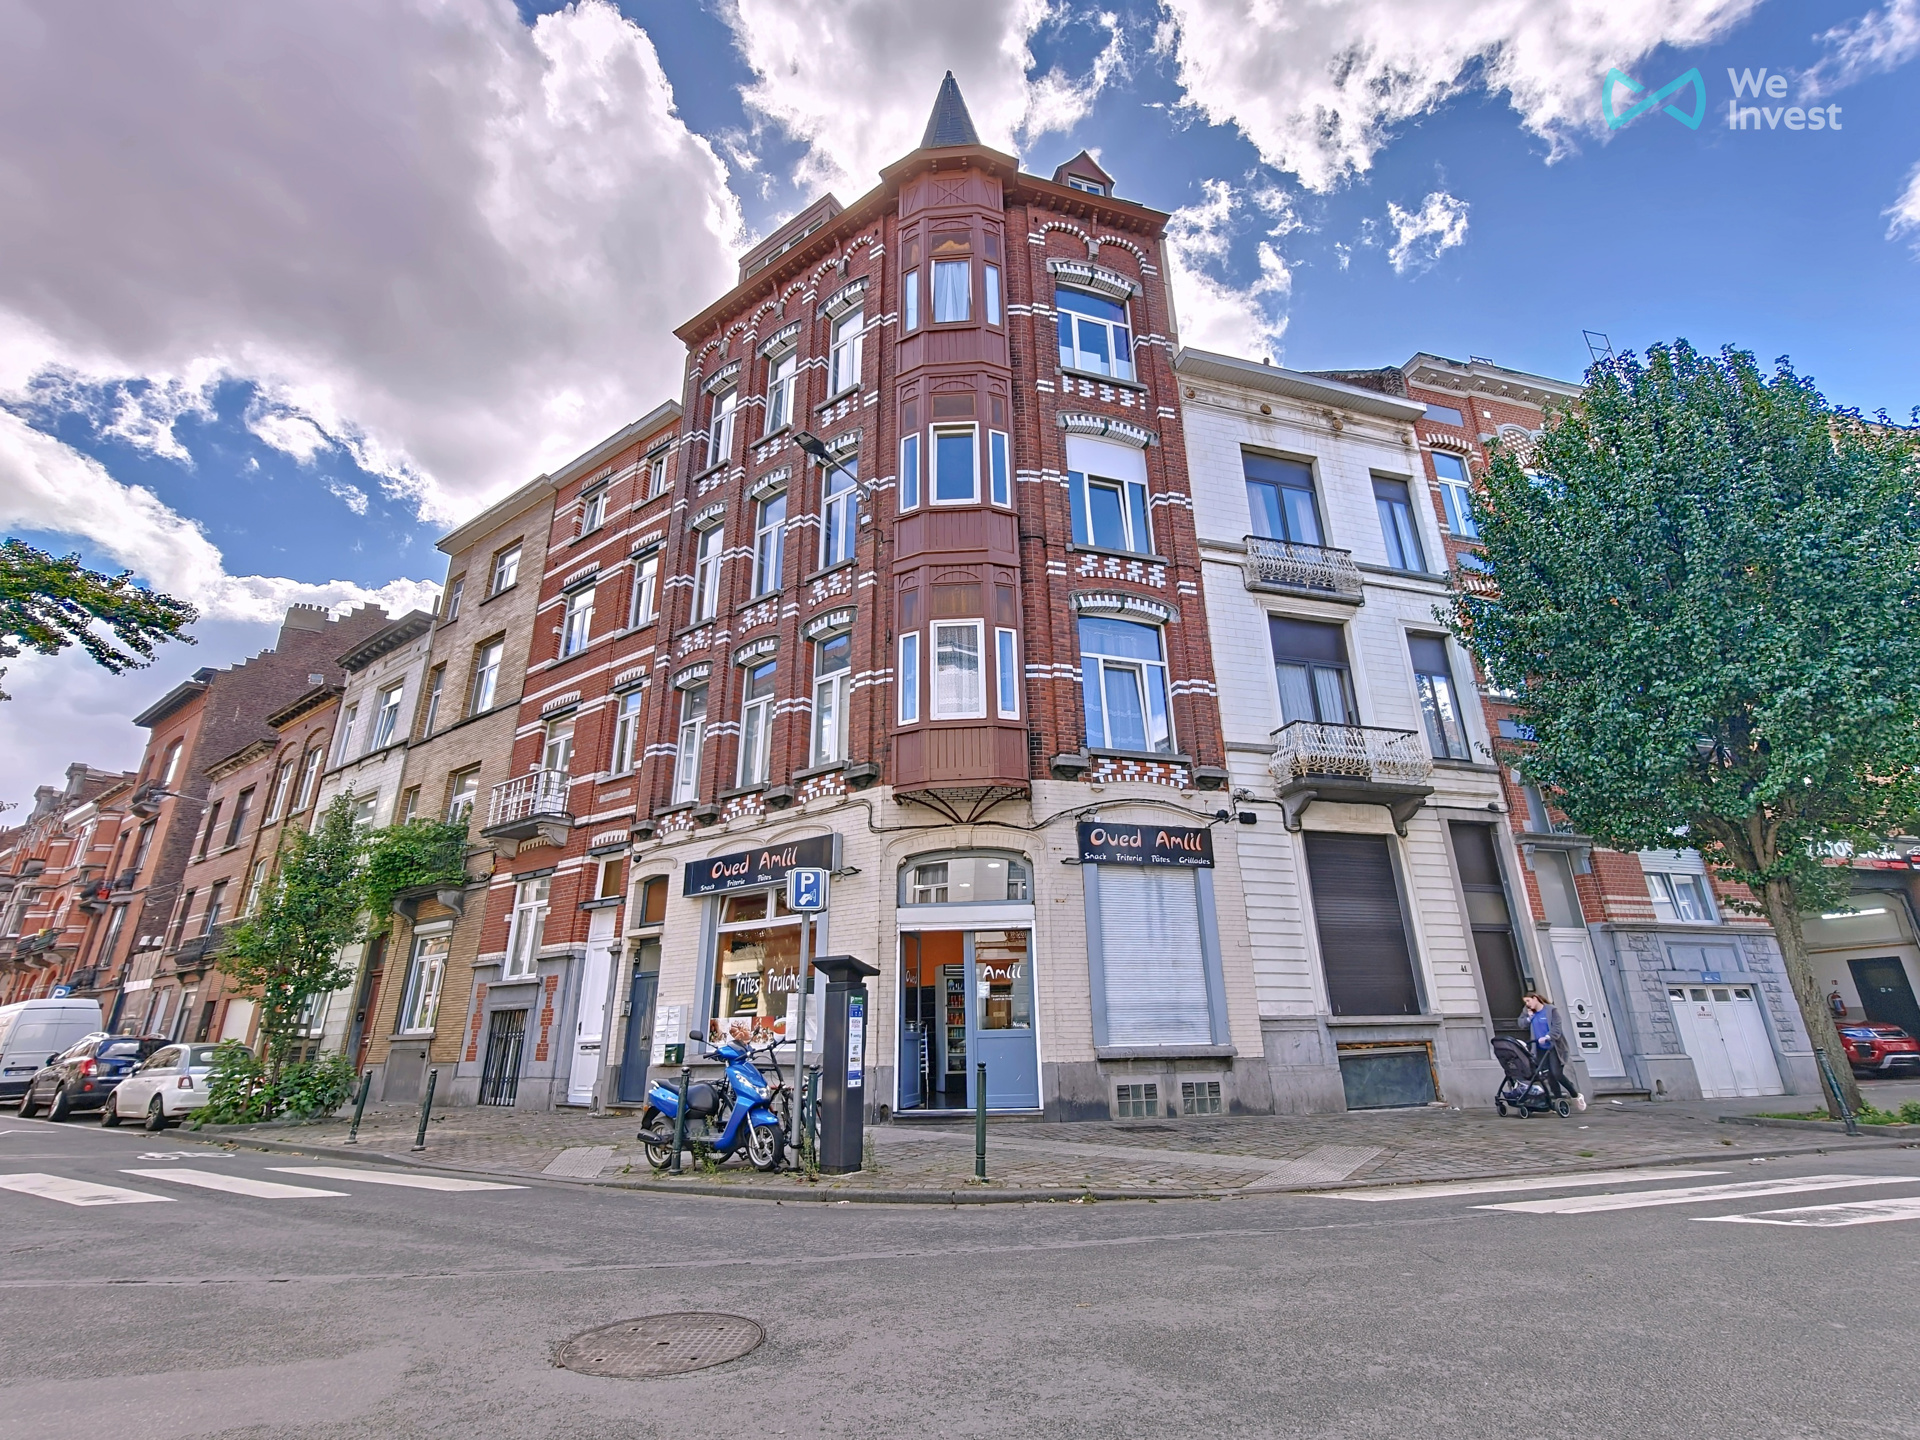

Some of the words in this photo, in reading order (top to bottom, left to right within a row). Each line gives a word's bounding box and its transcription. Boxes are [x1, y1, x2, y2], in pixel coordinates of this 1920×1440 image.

[1090, 828, 1142, 848] Oued
[1155, 830, 1202, 851] Amlil
[711, 853, 750, 879] Oued
[758, 846, 798, 871] Amlil
[1084, 851, 1107, 861] Snack
[1116, 853, 1143, 862] Friterie
[1178, 856, 1211, 865] Grillades
[700, 883, 715, 891] Snack
[801, 872, 815, 892] P
[982, 964, 1021, 979] Amlil
[735, 971, 760, 997] Frites
[51, 988, 66, 999] P
